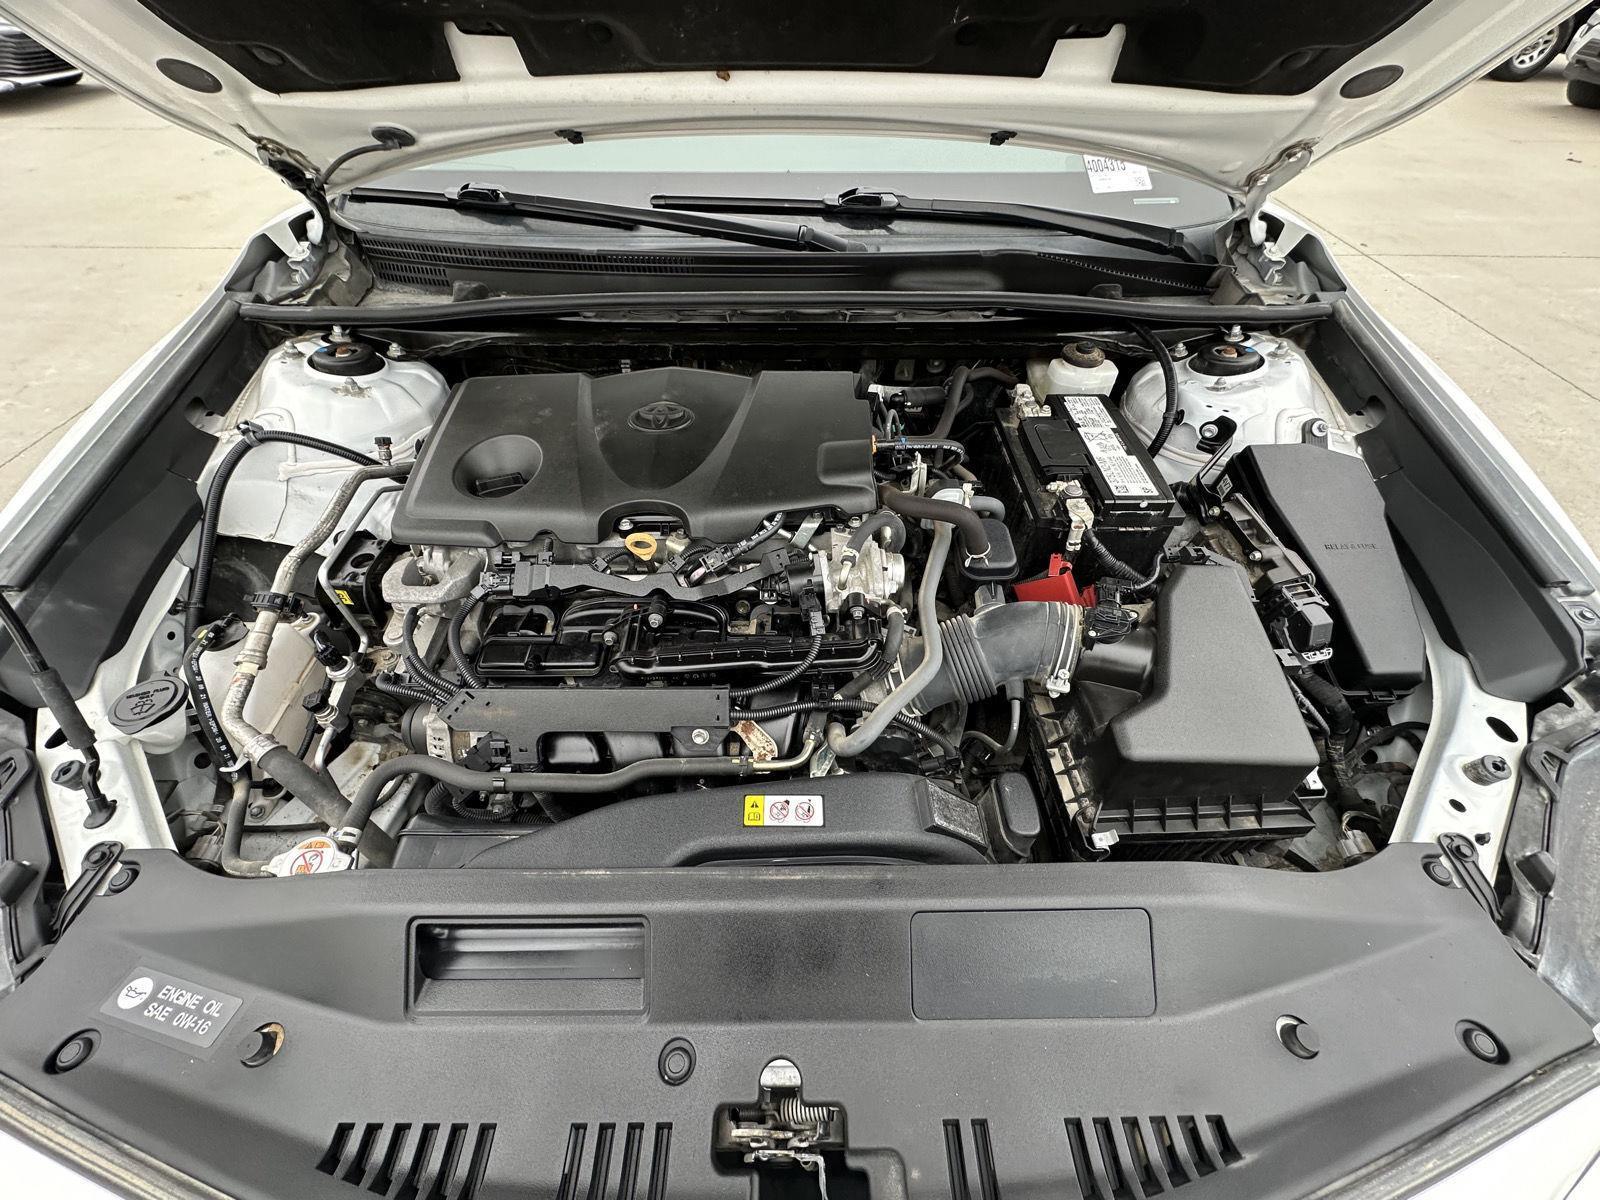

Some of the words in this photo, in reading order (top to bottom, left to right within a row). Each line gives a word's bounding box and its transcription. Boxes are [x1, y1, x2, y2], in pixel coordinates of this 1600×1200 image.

[157, 985, 203, 1009] ENGINE
[203, 1000, 223, 1017] OIL
[144, 1003, 173, 1021] SAE
[172, 1012, 211, 1034] 0W-16
